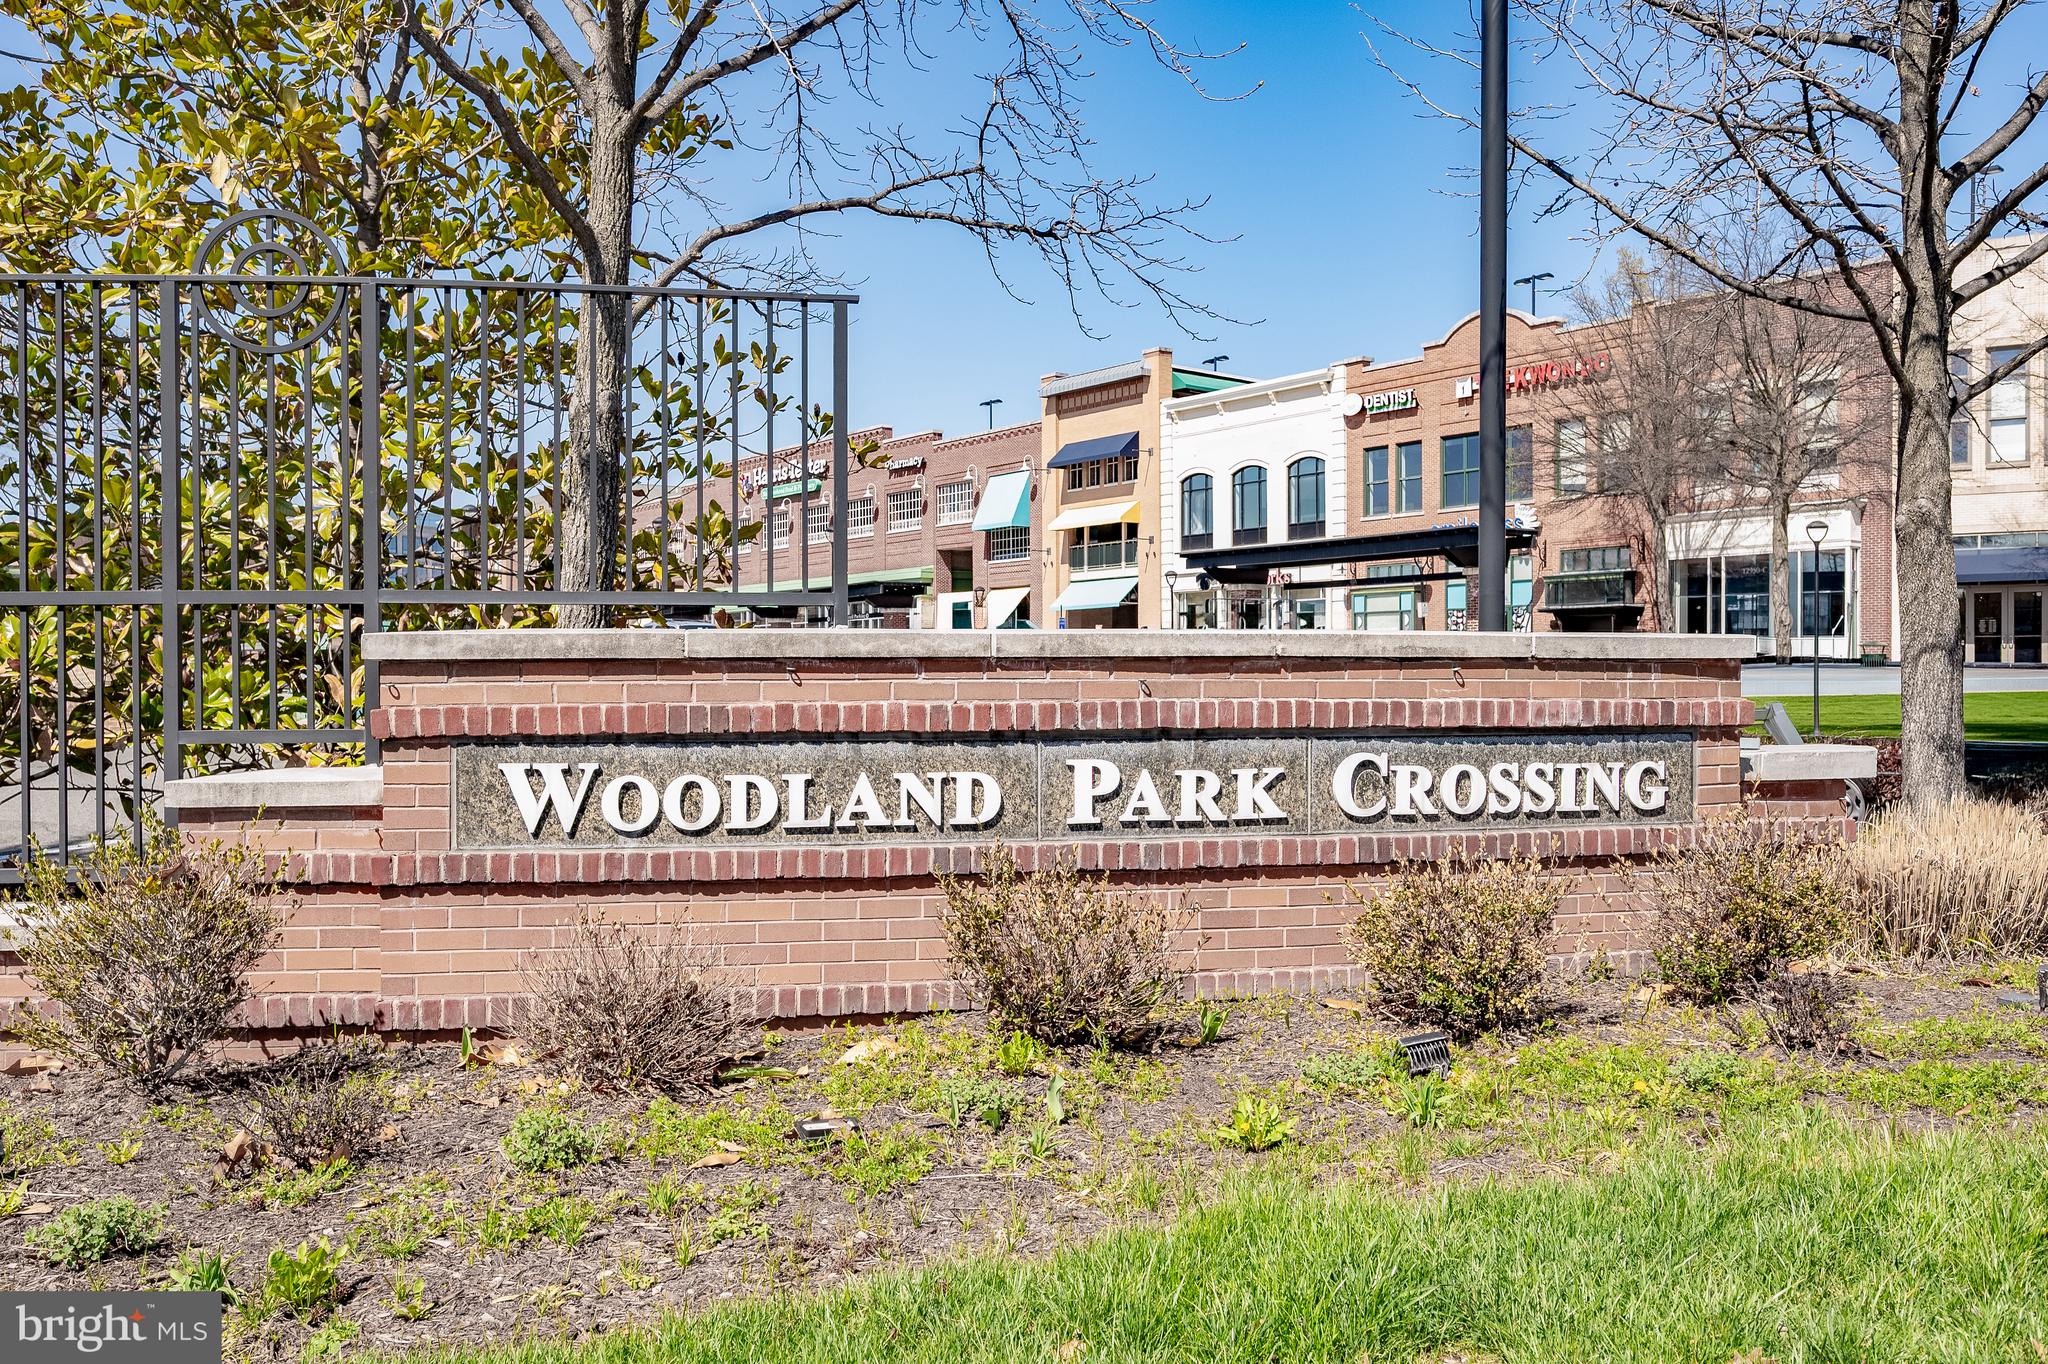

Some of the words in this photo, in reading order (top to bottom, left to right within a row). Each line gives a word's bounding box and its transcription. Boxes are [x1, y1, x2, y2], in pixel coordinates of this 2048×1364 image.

[1363, 388, 1415, 409] DENTIST
[753, 464, 788, 486] Haris
[788, 459, 826, 479] Teter
[884, 456, 923, 471] Pharmacy
[498, 762, 1003, 836] WOODLAND
[1066, 758, 1289, 825] PARK
[1332, 752, 1669, 818] CROSSING
